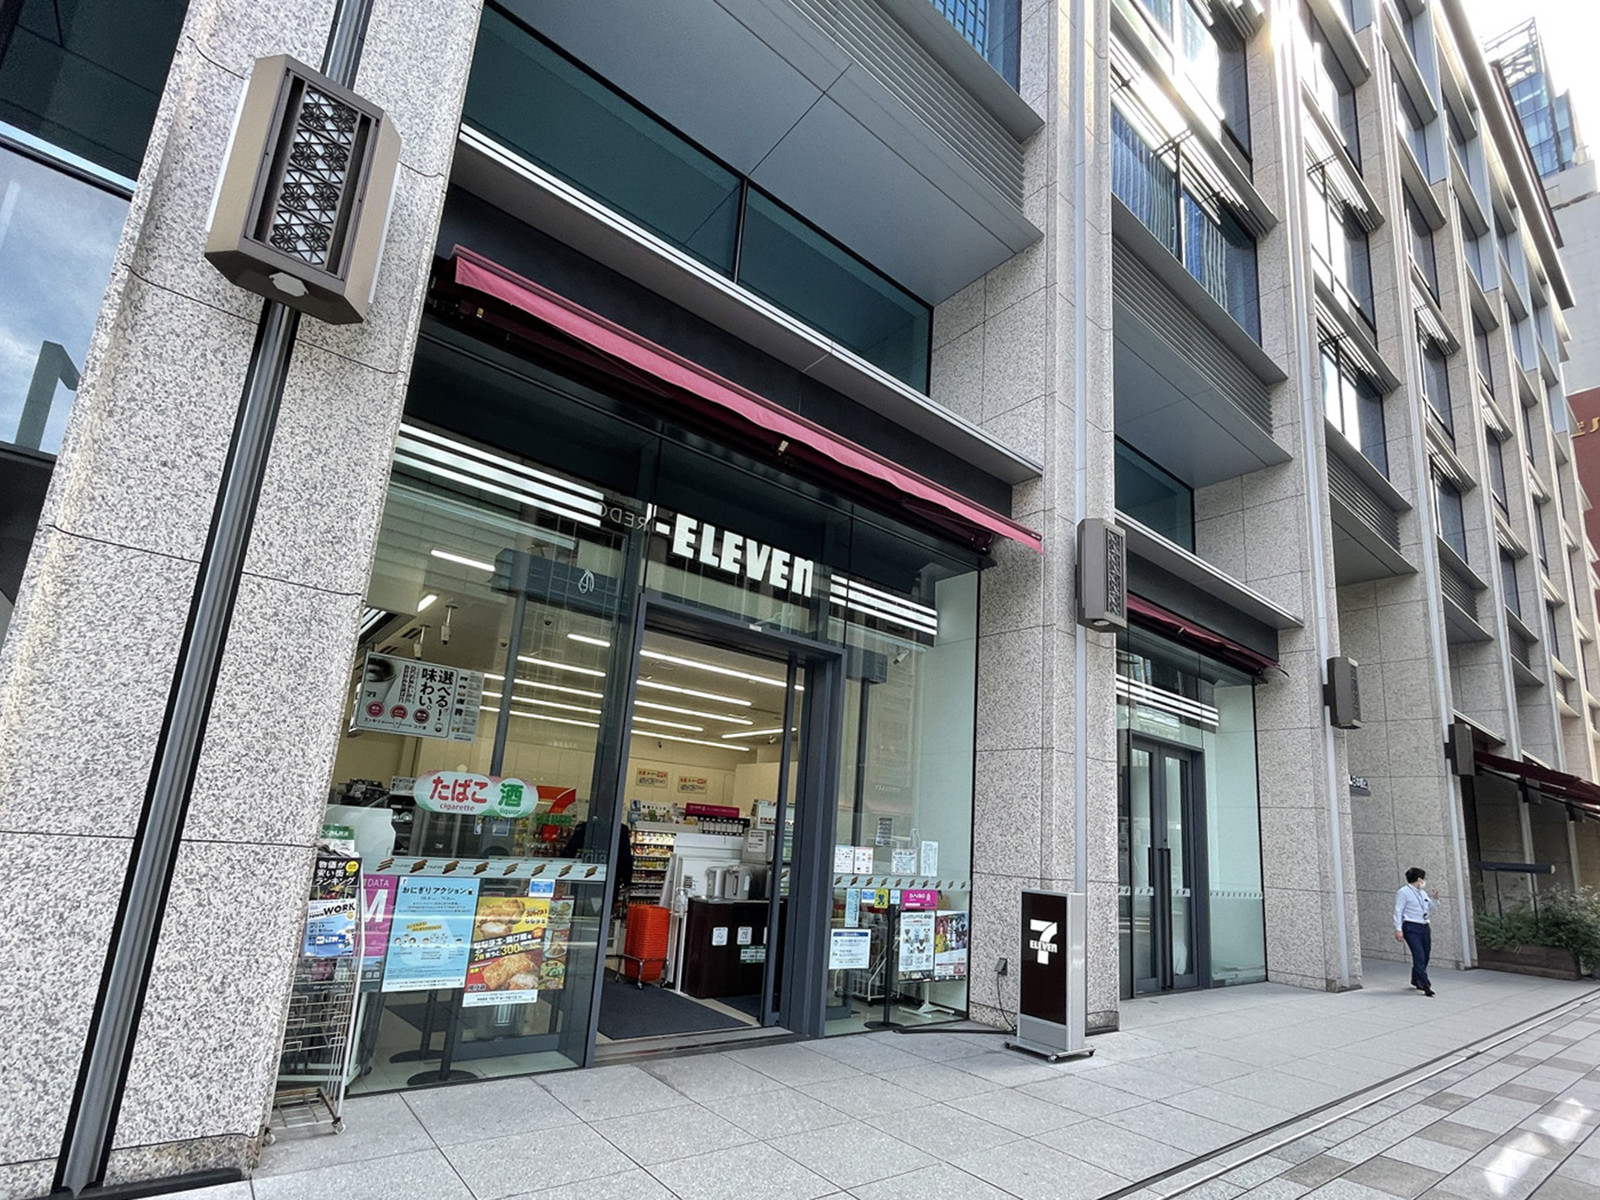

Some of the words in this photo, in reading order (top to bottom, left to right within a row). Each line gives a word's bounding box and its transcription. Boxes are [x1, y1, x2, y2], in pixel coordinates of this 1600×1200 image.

[429, 776, 488, 804] たばこ
[498, 783, 524, 808] 酒
[439, 803, 475, 812] cigarette
[315, 877, 356, 886] ランキング
[367, 878, 390, 888] DATA
[402, 886, 467, 895] おにぎりアクション
